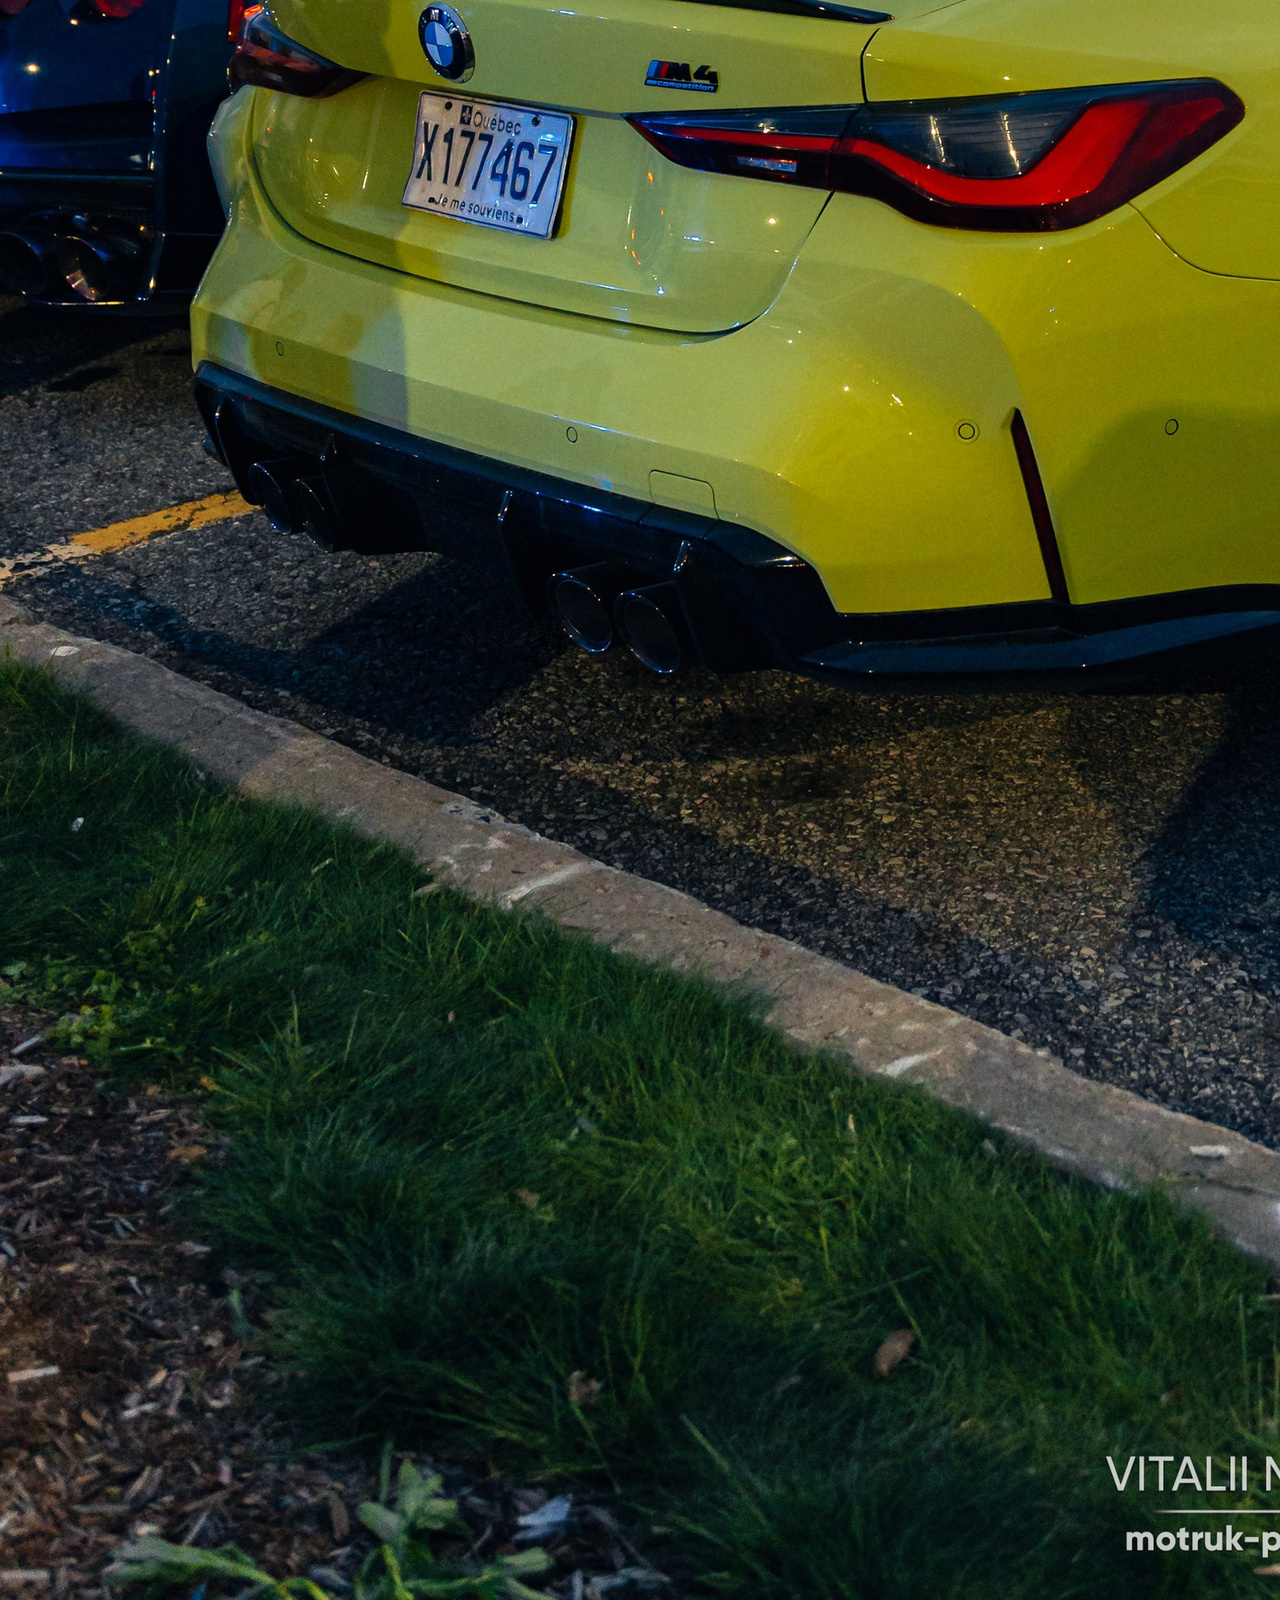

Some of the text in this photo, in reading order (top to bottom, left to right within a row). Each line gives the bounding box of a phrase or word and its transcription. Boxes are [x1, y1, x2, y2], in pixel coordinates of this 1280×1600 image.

[663, 60, 718, 84] M4
[473, 111, 521, 135] Québec
[416, 121, 558, 204] X177467
[434, 193, 515, 222] Je me souviens
